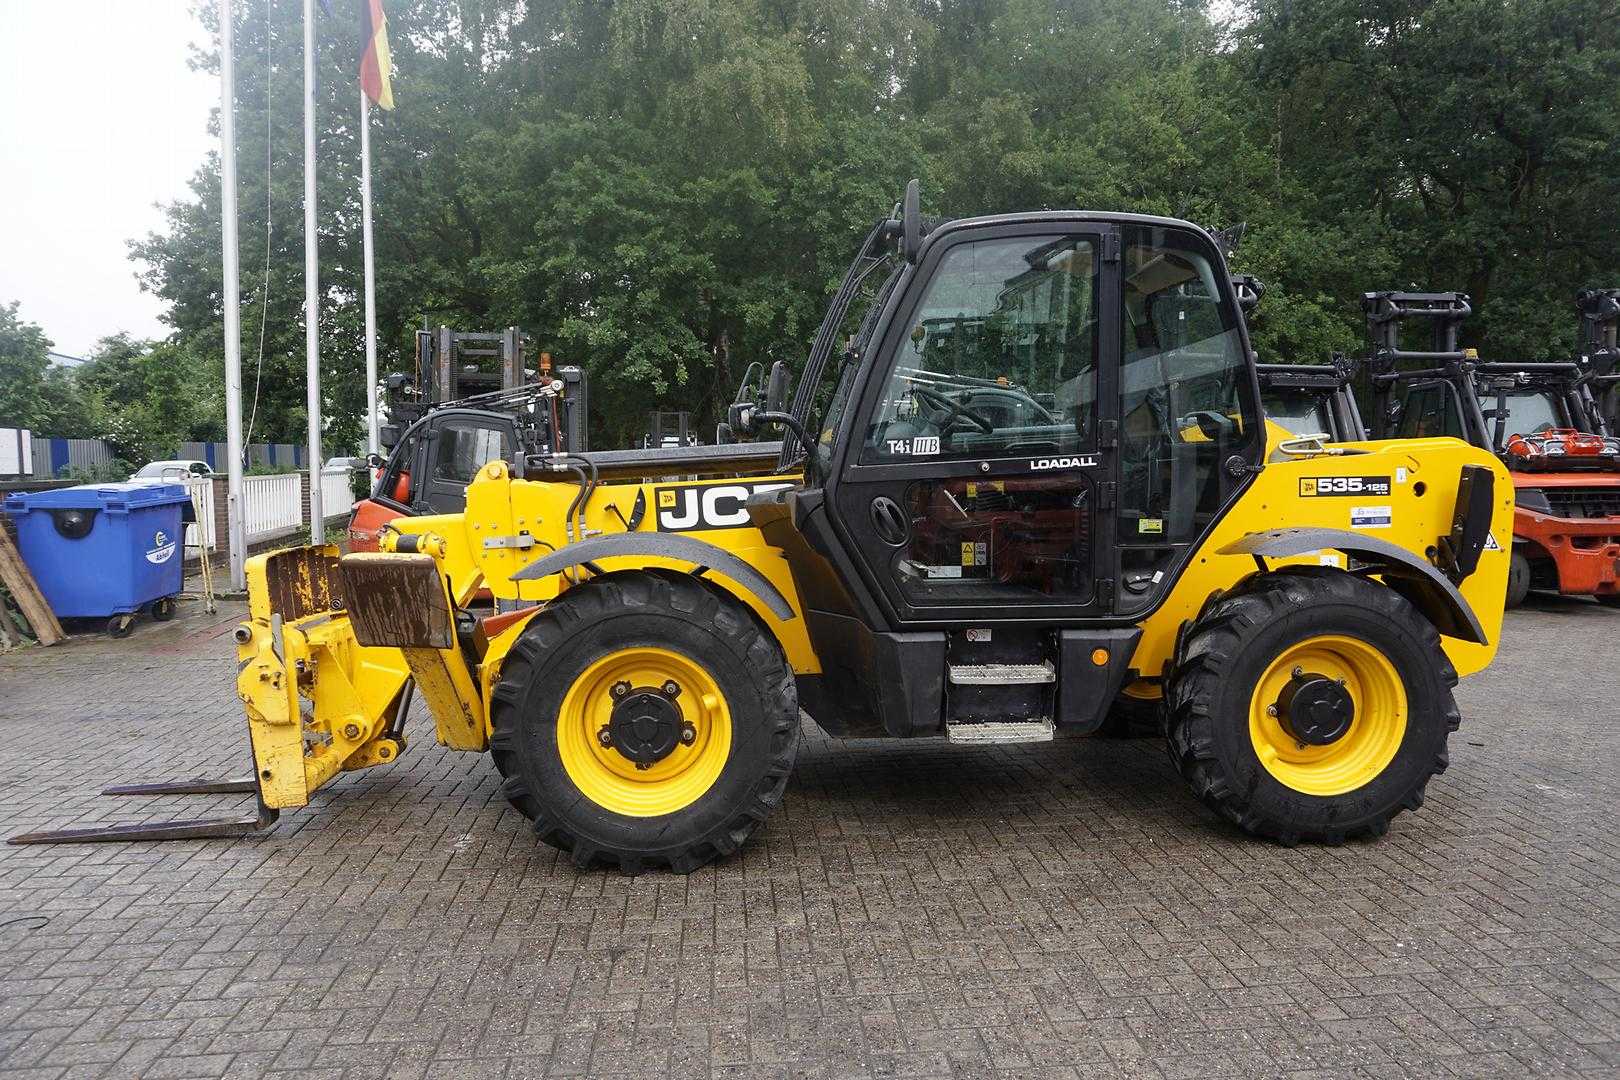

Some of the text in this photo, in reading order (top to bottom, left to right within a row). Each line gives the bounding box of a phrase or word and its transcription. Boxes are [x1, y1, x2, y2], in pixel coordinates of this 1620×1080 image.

[886, 439, 911, 454] T4i
[1030, 457, 1097, 470] LOADALL
[1317, 477, 1388, 492] 535-125
[660, 484, 795, 529] JC
